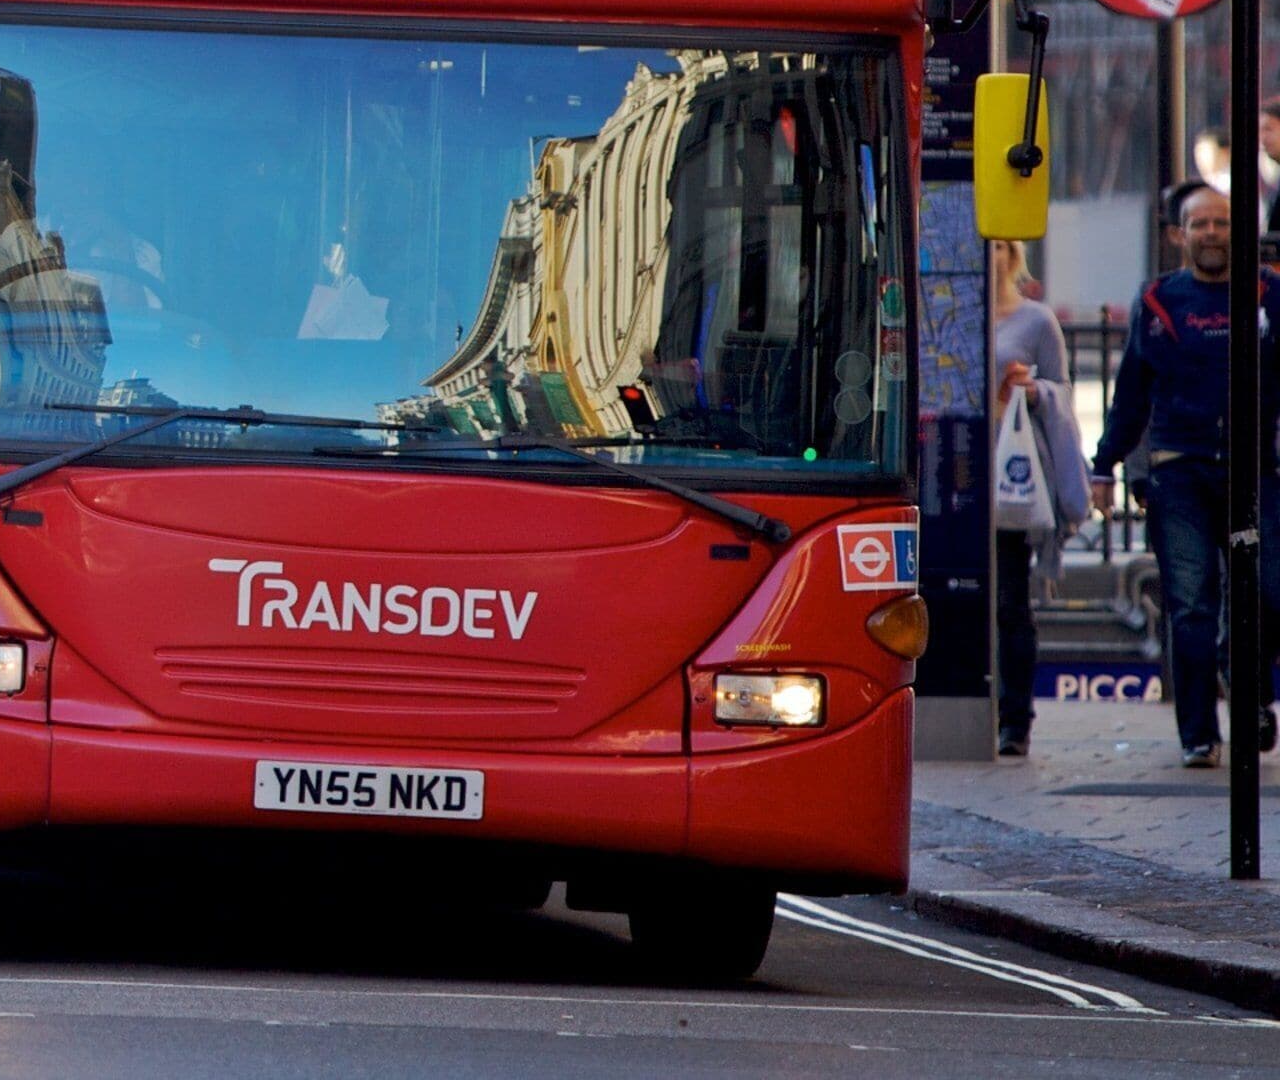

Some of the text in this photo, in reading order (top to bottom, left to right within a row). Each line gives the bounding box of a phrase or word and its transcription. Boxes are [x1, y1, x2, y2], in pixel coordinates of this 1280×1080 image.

[209, 559, 538, 640] TRANSDEV
[1057, 674, 1162, 702] PICCA
[273, 767, 468, 812] YN55 NKD
